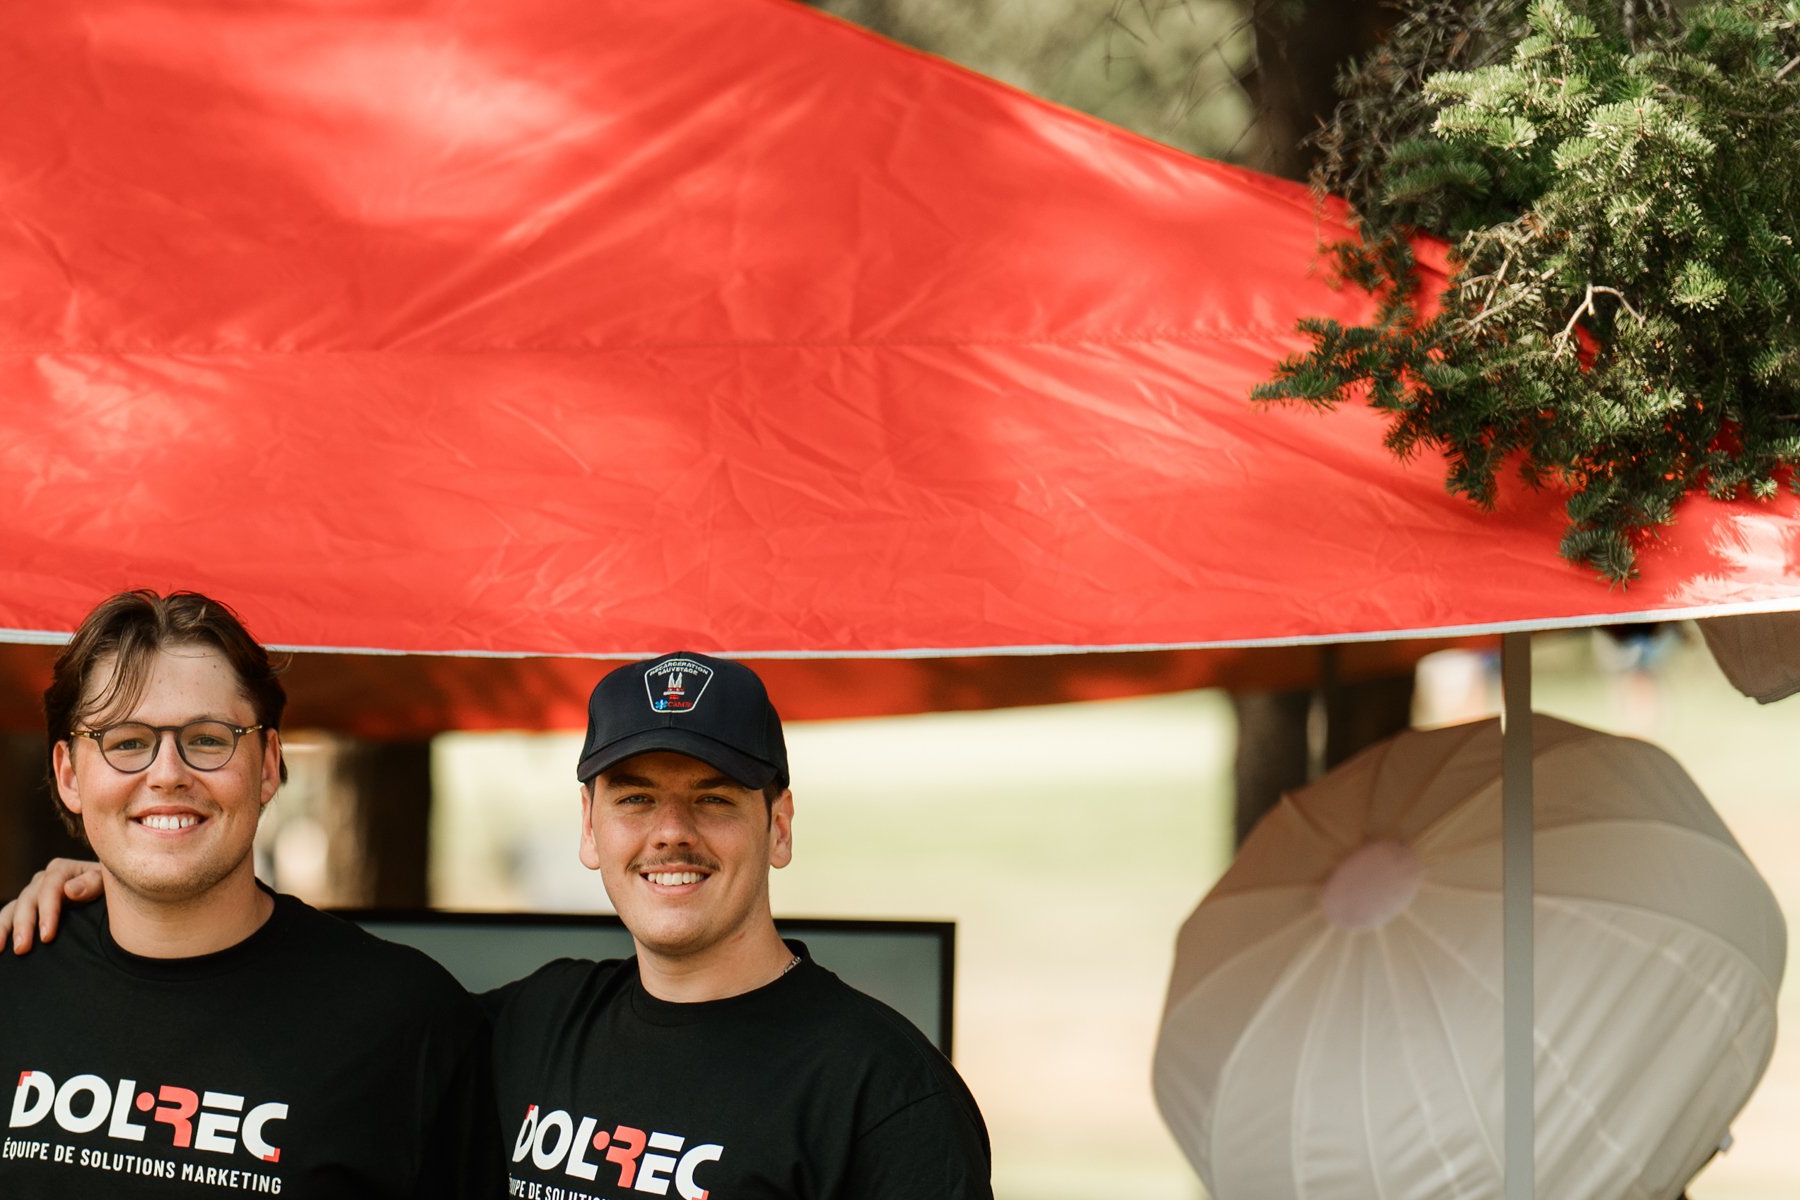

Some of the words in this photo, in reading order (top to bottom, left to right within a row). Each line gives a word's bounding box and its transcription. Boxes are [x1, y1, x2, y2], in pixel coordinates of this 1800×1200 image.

[2, 1137, 50, 1160] ÉQUIPE
[54, 1143, 75, 1163] DE
[80, 1148, 176, 1178] SOLUTIONS
[181, 1163, 281, 1195] MARKETING
[528, 1181, 542, 1200] DE
